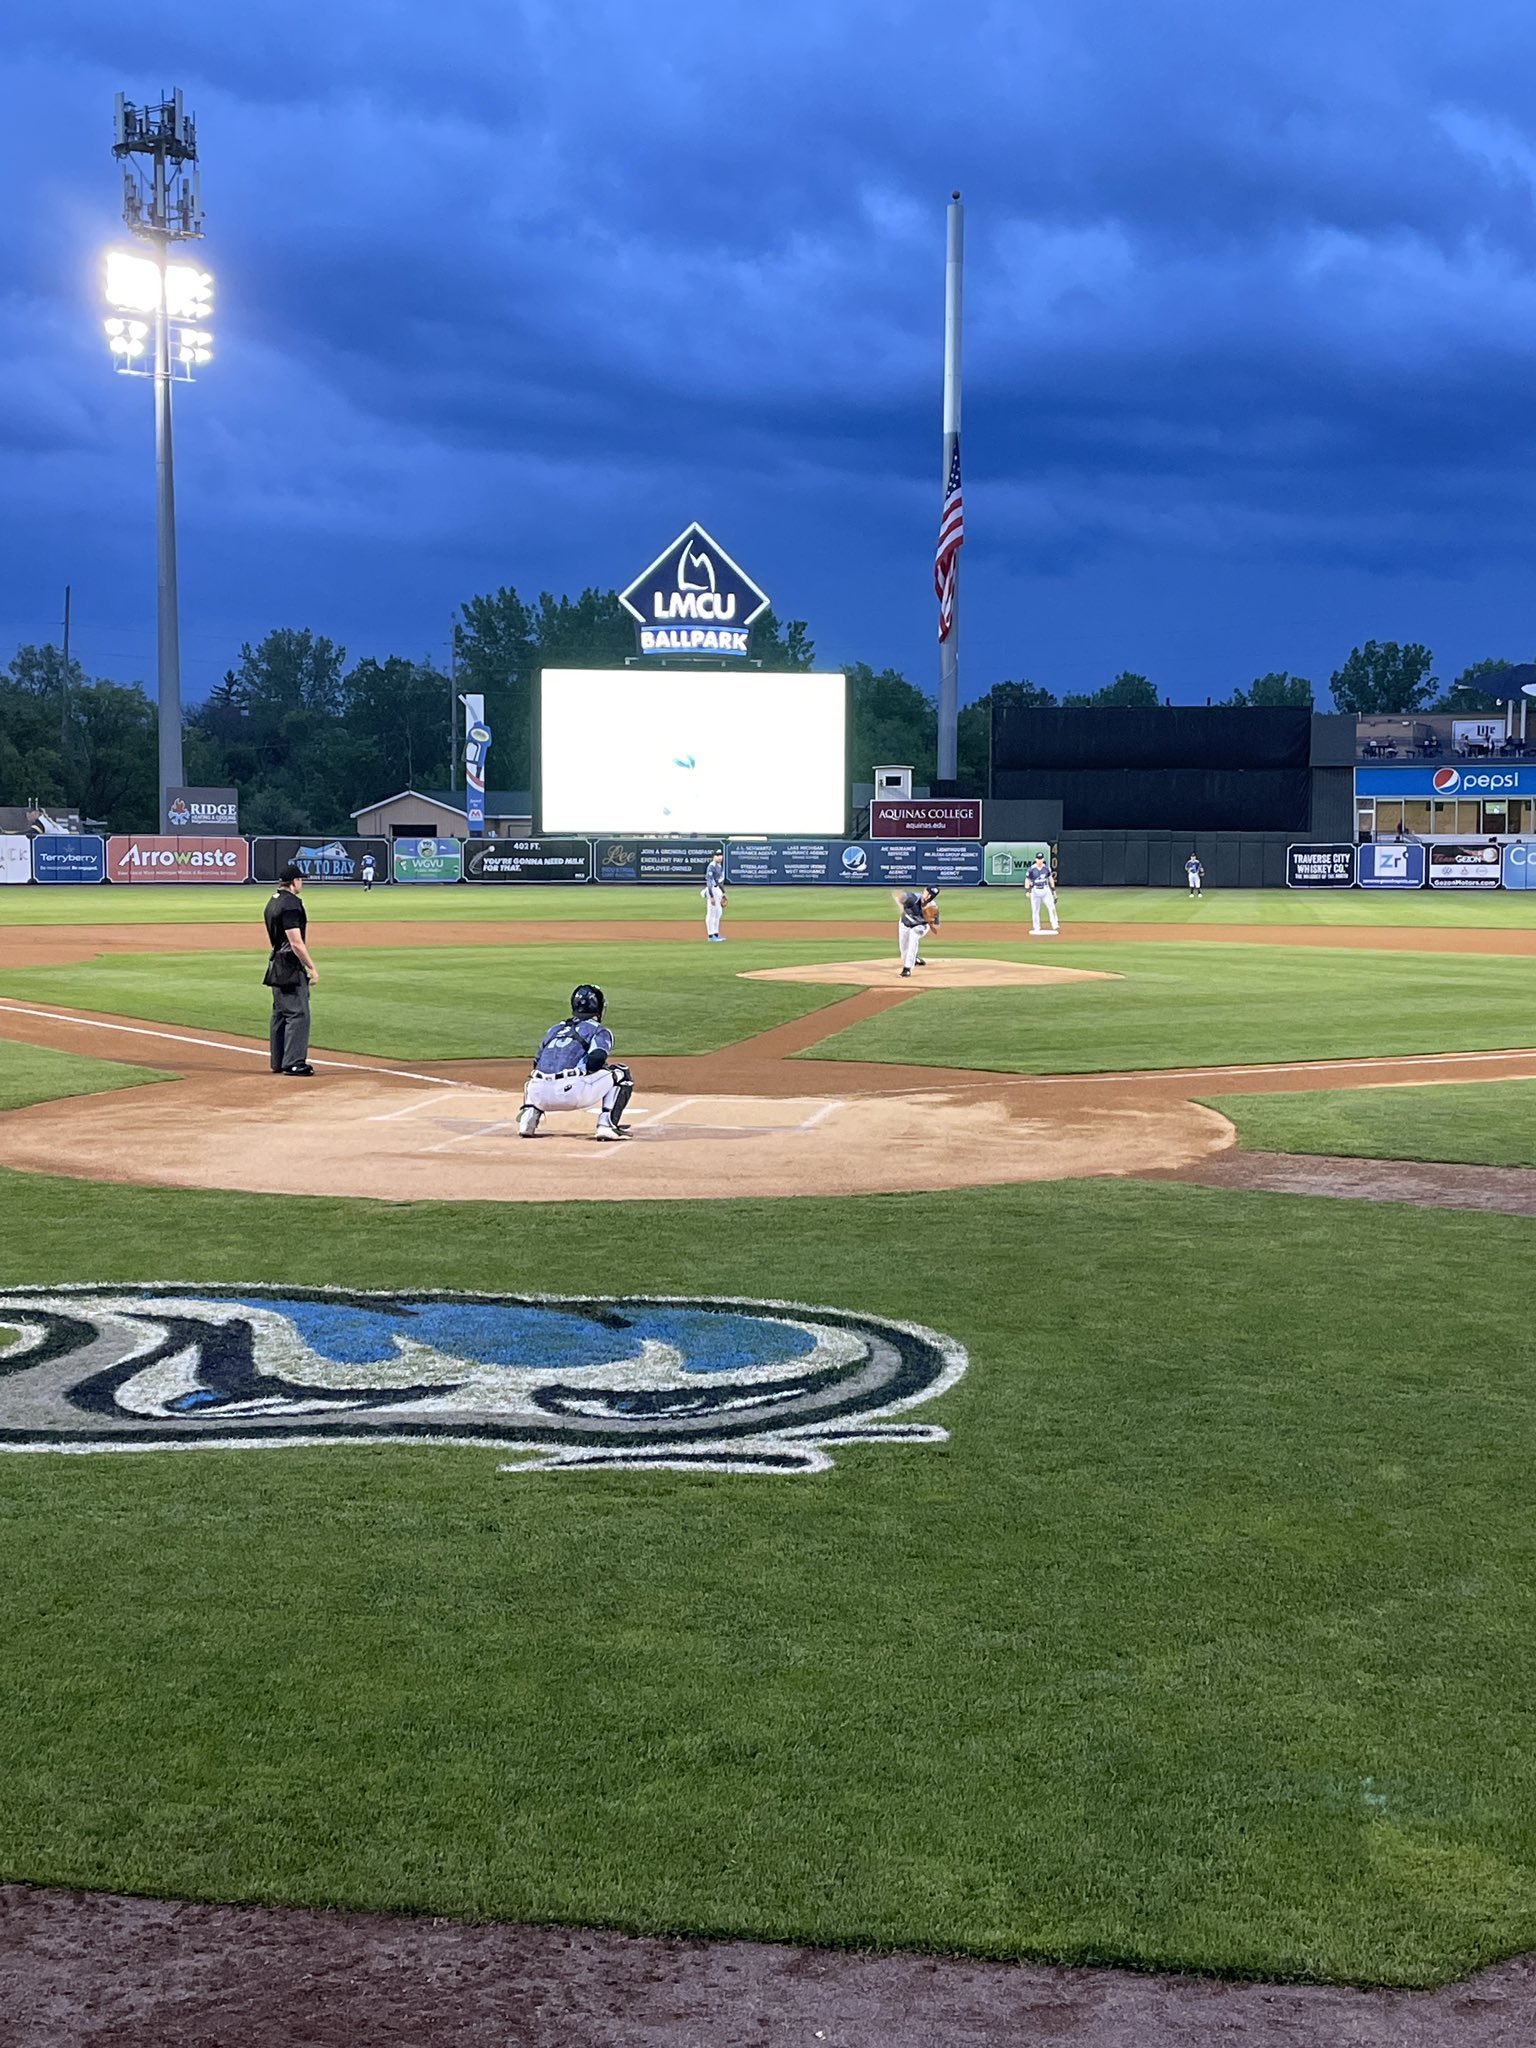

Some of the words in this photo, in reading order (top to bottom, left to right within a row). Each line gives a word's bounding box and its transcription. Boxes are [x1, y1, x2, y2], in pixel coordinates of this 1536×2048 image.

[654, 592, 735, 619] LMCU
[641, 630, 747, 650] BALLPARK
[1464, 772, 1518, 790] pepsi
[190, 804, 236, 815] RIDGE
[879, 809, 925, 820] AQUINAS
[928, 809, 973, 818] COLLEGE
[40, 853, 97, 863] Terryberry
[119, 843, 237, 867] Arrowaste
[602, 845, 636, 866] Lee
[1293, 854, 1331, 864] TRAVERSE
[1333, 854, 1350, 863] CITY
[314, 861, 330, 875] TO
[333, 861, 356, 875] BAY
[412, 860, 444, 868] WGVU
[1297, 864, 1331, 873] WHISKEY
